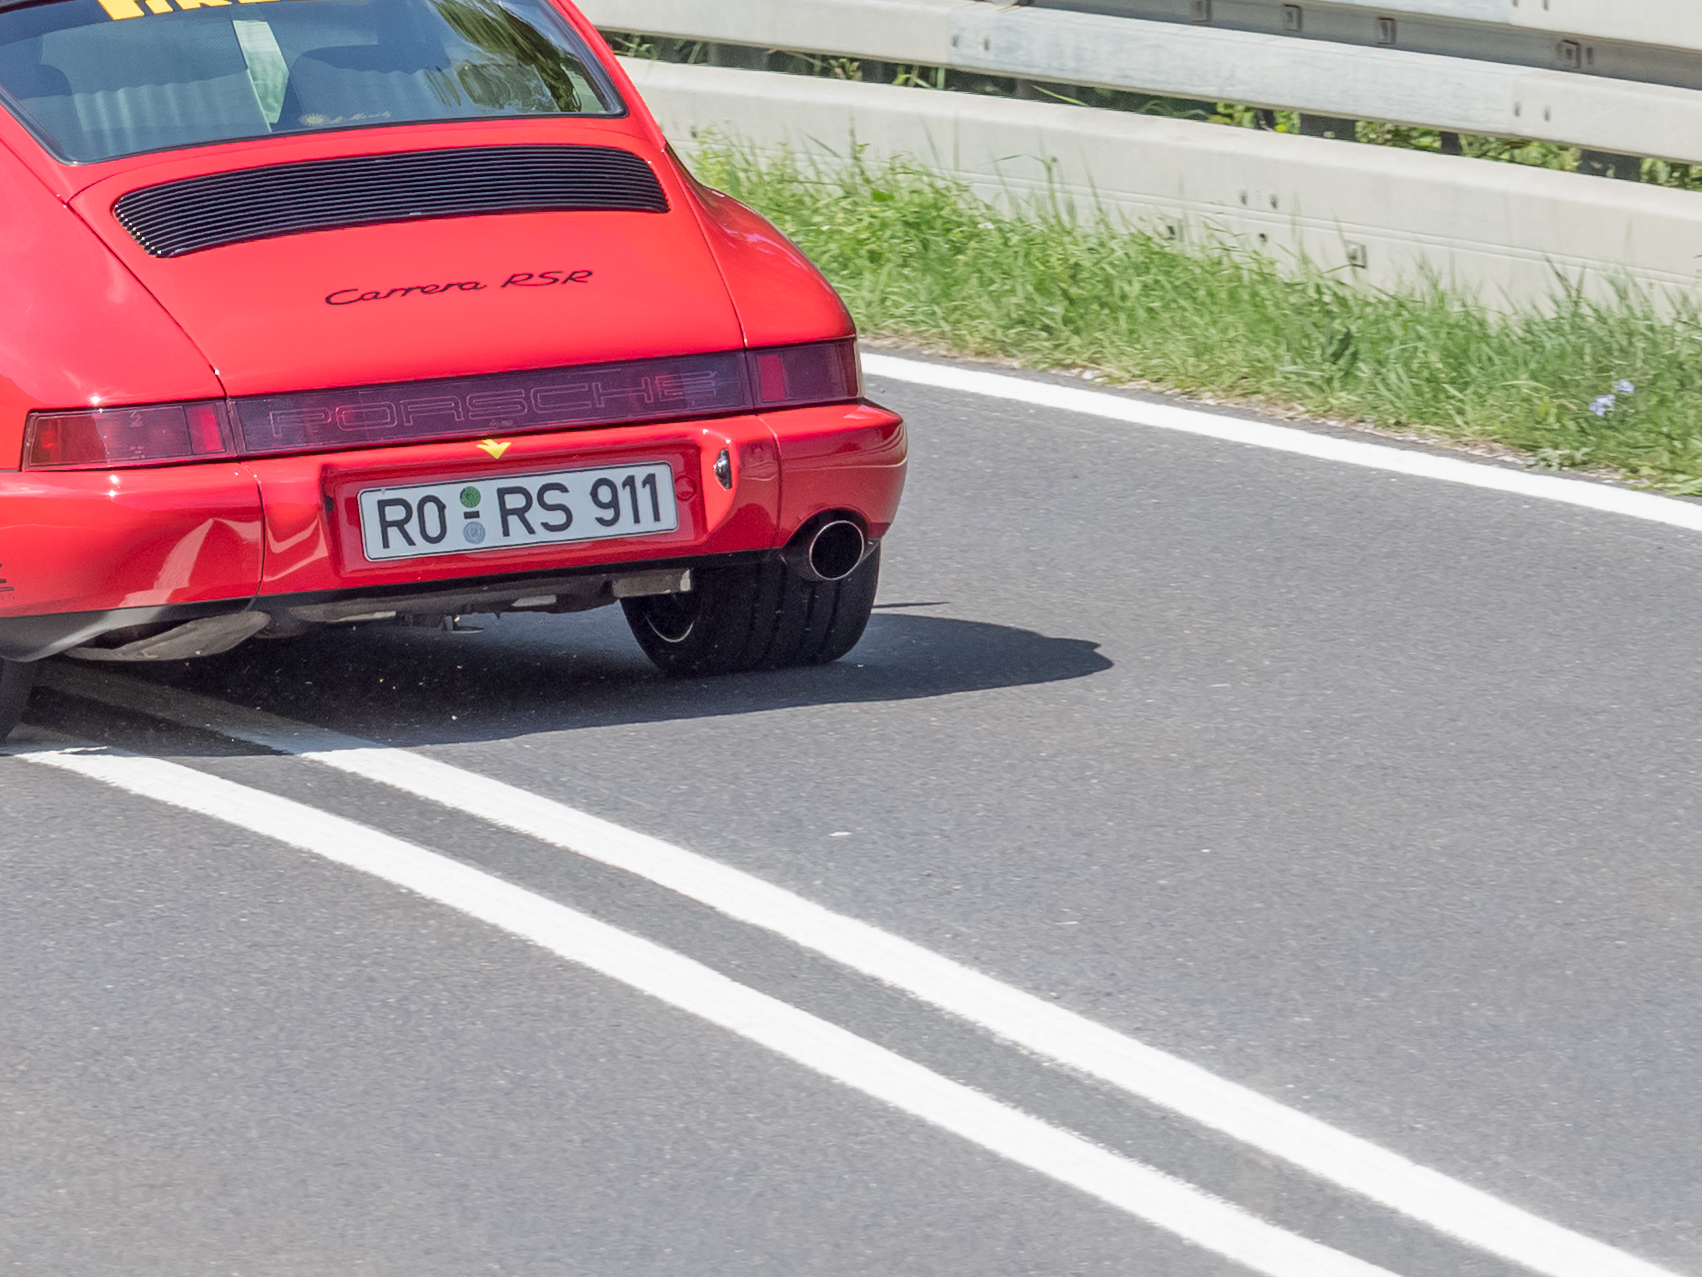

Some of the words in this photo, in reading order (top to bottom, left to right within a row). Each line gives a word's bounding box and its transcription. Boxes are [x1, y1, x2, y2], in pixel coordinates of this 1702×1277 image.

[325, 281, 487, 306] Carrera
[501, 270, 593, 289] RSR
[269, 370, 718, 438] PORSCHE
[377, 495, 447, 549] RO
[497, 482, 573, 537] RS
[590, 473, 661, 527] 911
